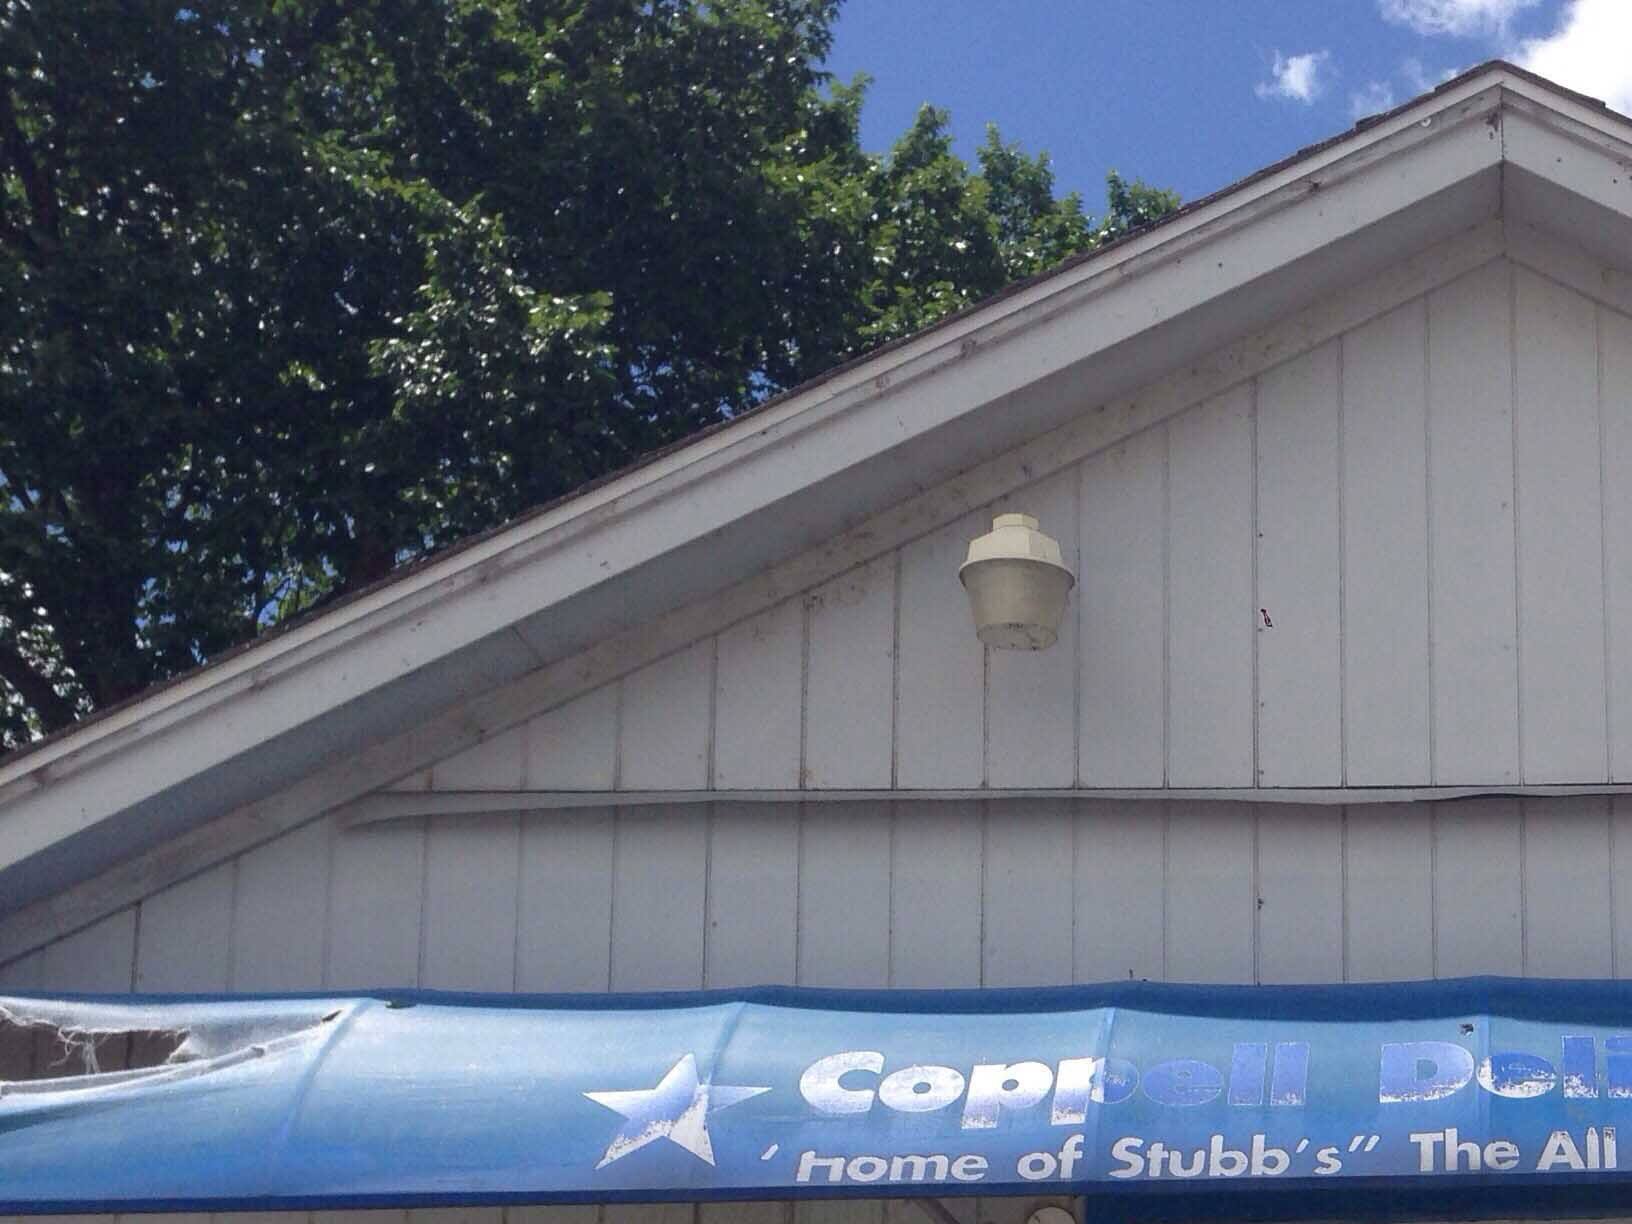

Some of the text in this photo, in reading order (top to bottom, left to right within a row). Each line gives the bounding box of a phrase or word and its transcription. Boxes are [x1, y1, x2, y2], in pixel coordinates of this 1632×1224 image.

[799, 1042, 1310, 1130] Coppell
[1016, 1134, 1085, 1181] of
[1410, 1128, 1520, 1172] The
[1536, 1126, 1617, 1171] All
